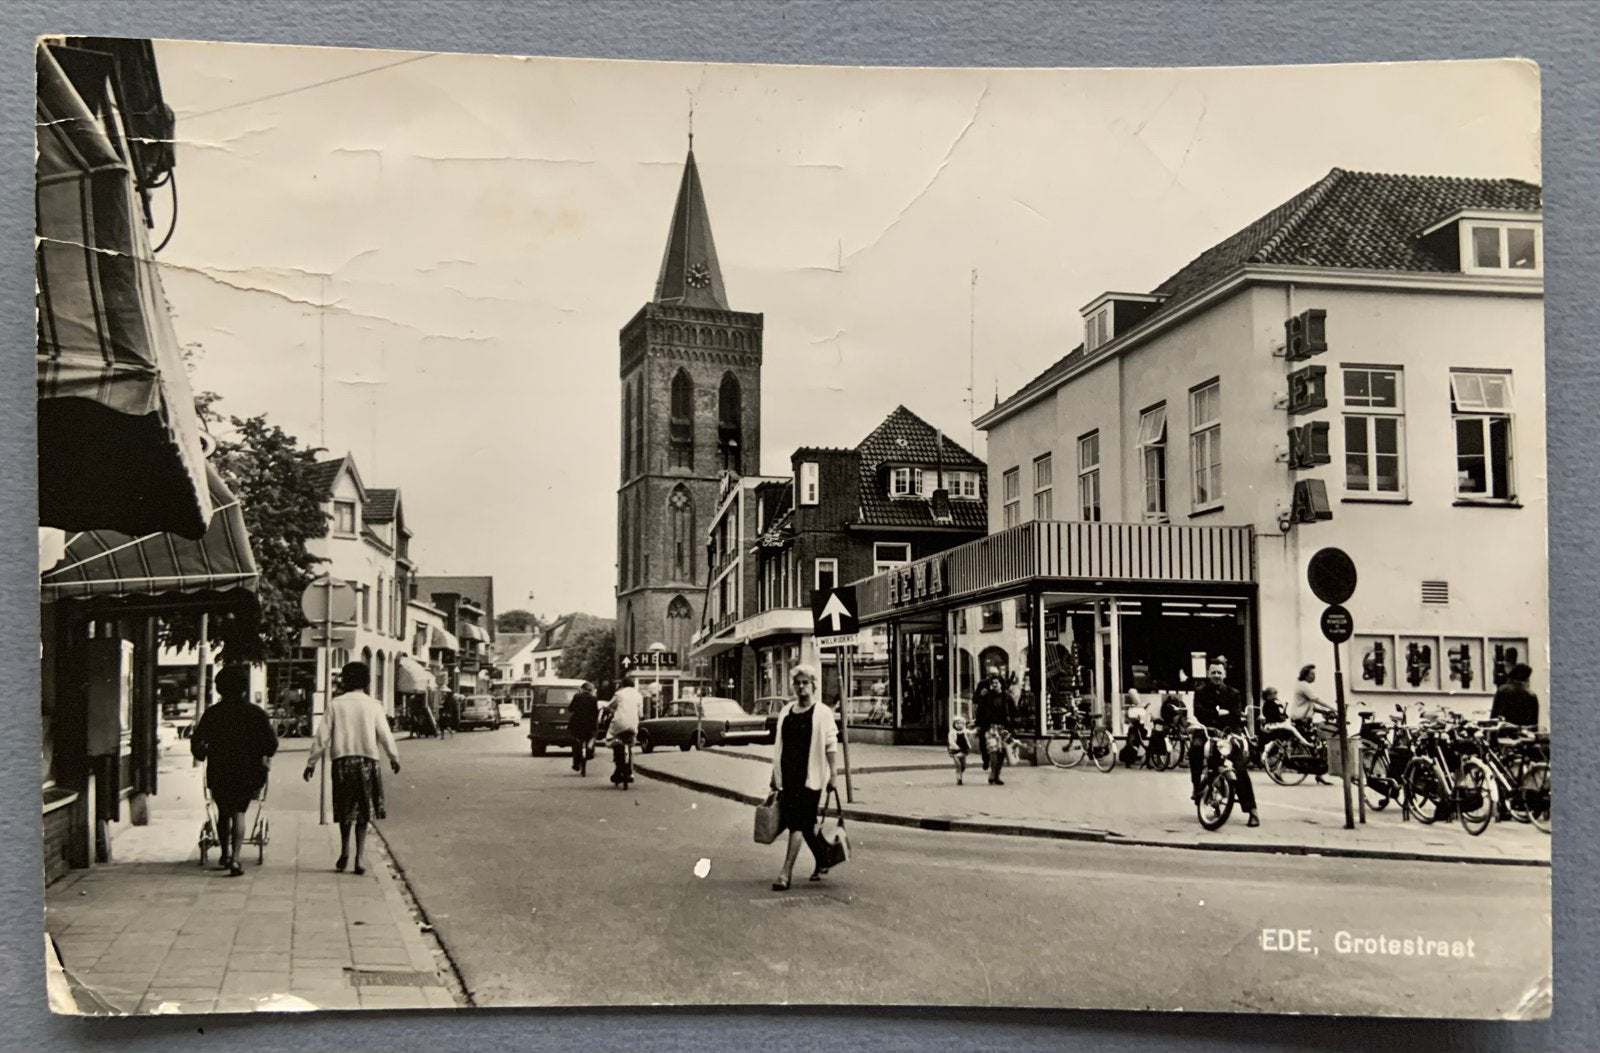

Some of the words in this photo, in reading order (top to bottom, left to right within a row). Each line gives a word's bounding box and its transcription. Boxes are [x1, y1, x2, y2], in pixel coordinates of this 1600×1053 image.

[1285, 309, 1332, 524] HEMA
[887, 559, 943, 605] HEMA
[633, 653, 675, 664] SHELL
